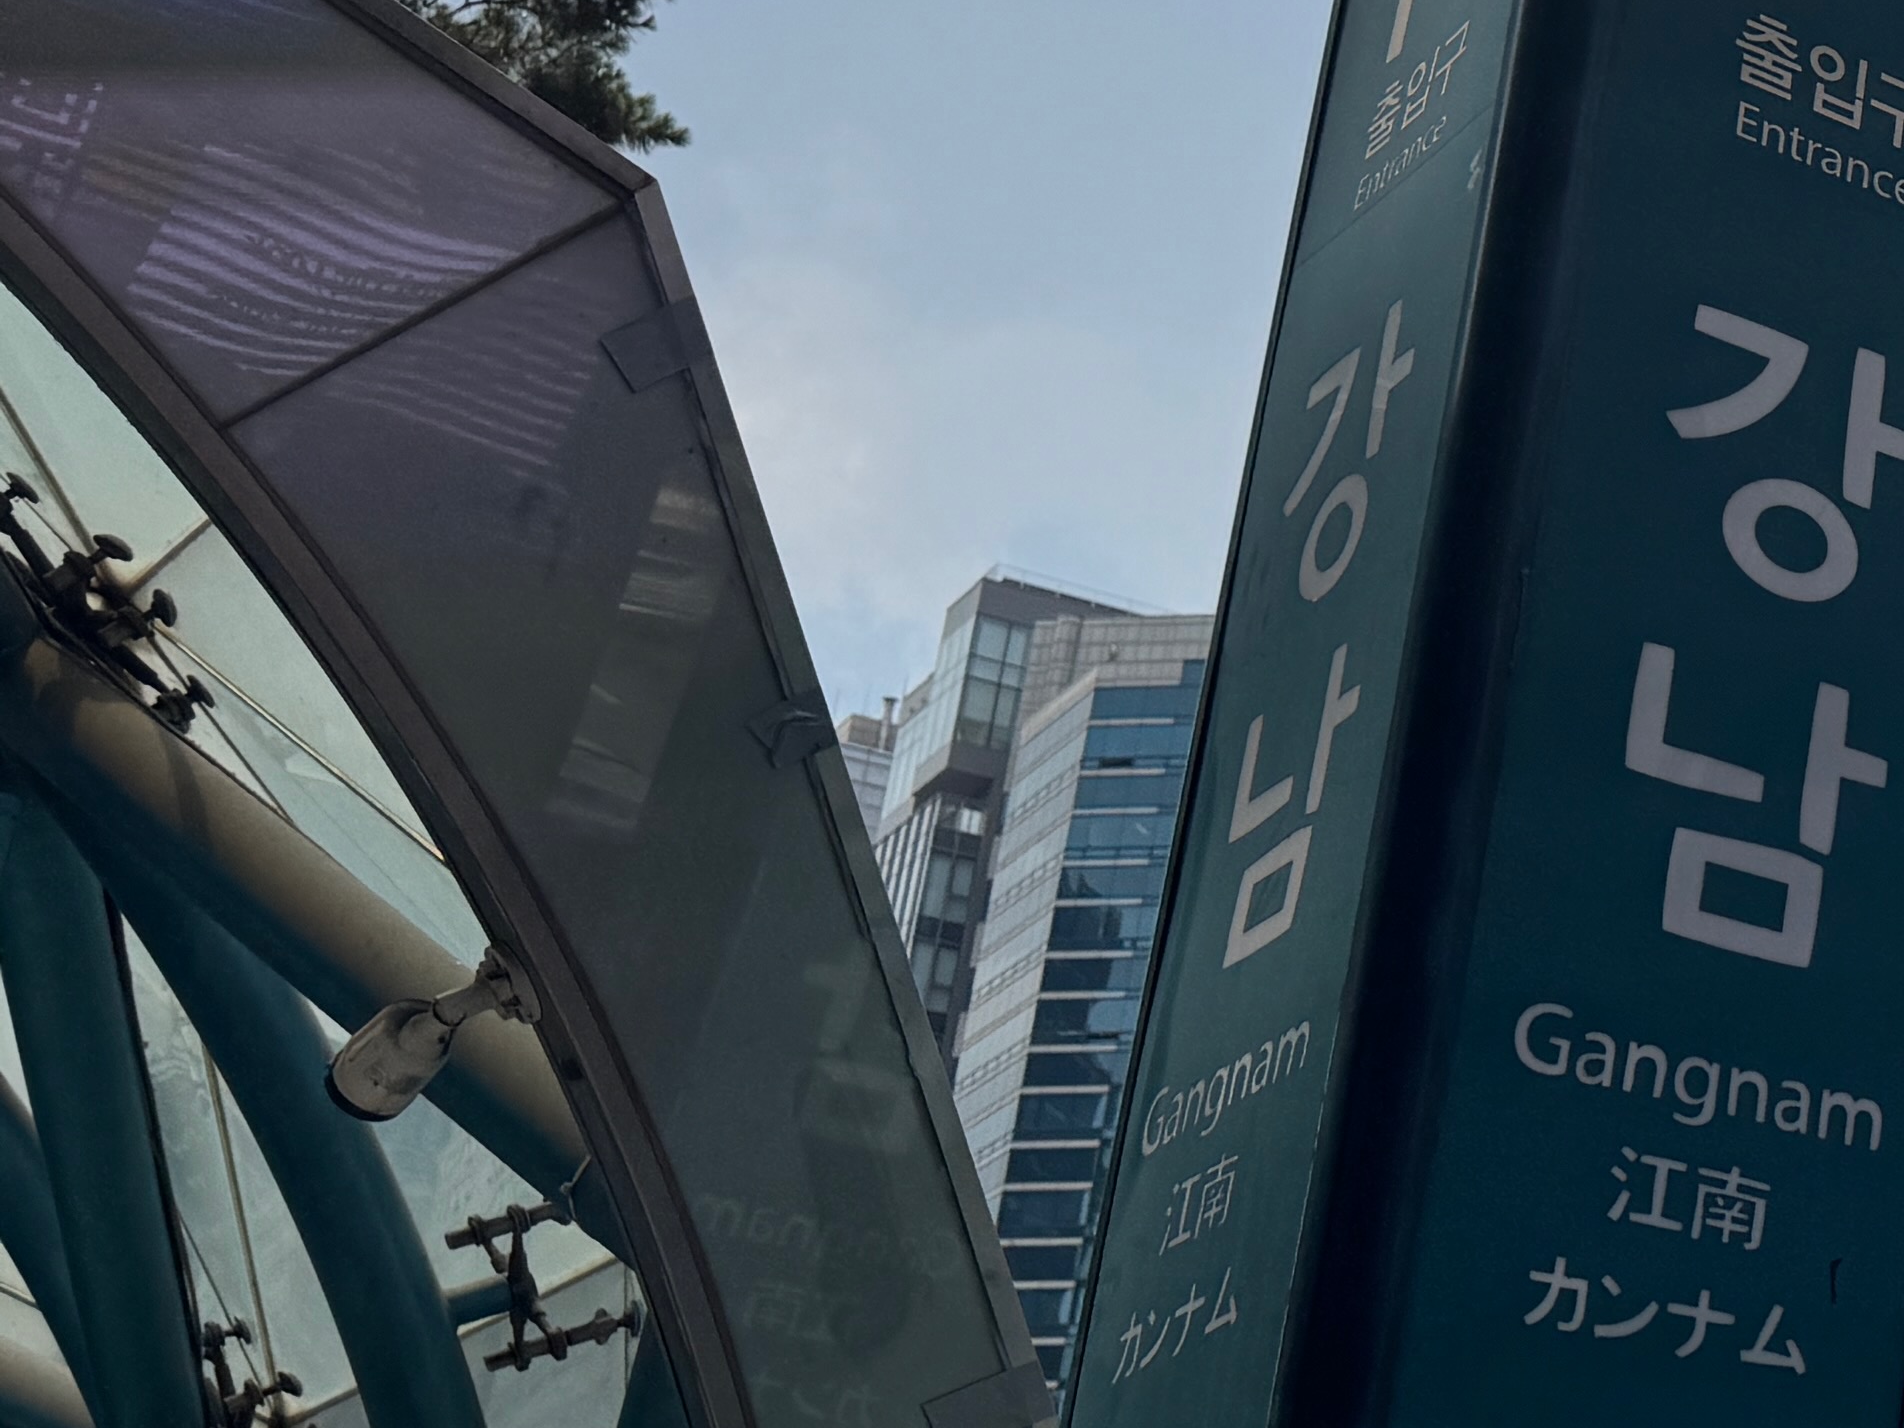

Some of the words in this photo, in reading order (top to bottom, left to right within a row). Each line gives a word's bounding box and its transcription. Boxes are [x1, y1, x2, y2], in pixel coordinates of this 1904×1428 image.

[1365, 20, 1471, 160] 출입구
[1352, 115, 1447, 210] Entrance
[1221, 298, 1416, 970] 강남
[1140, 1018, 1312, 1156] Gangnam
[1512, 1001, 1885, 1153] Gangnam
[1160, 1154, 1235, 1257] 江南
[1608, 1147, 1770, 1251] 江南
[1112, 1267, 1238, 1385] カンナム
[1524, 1255, 1808, 1376] カンナム
